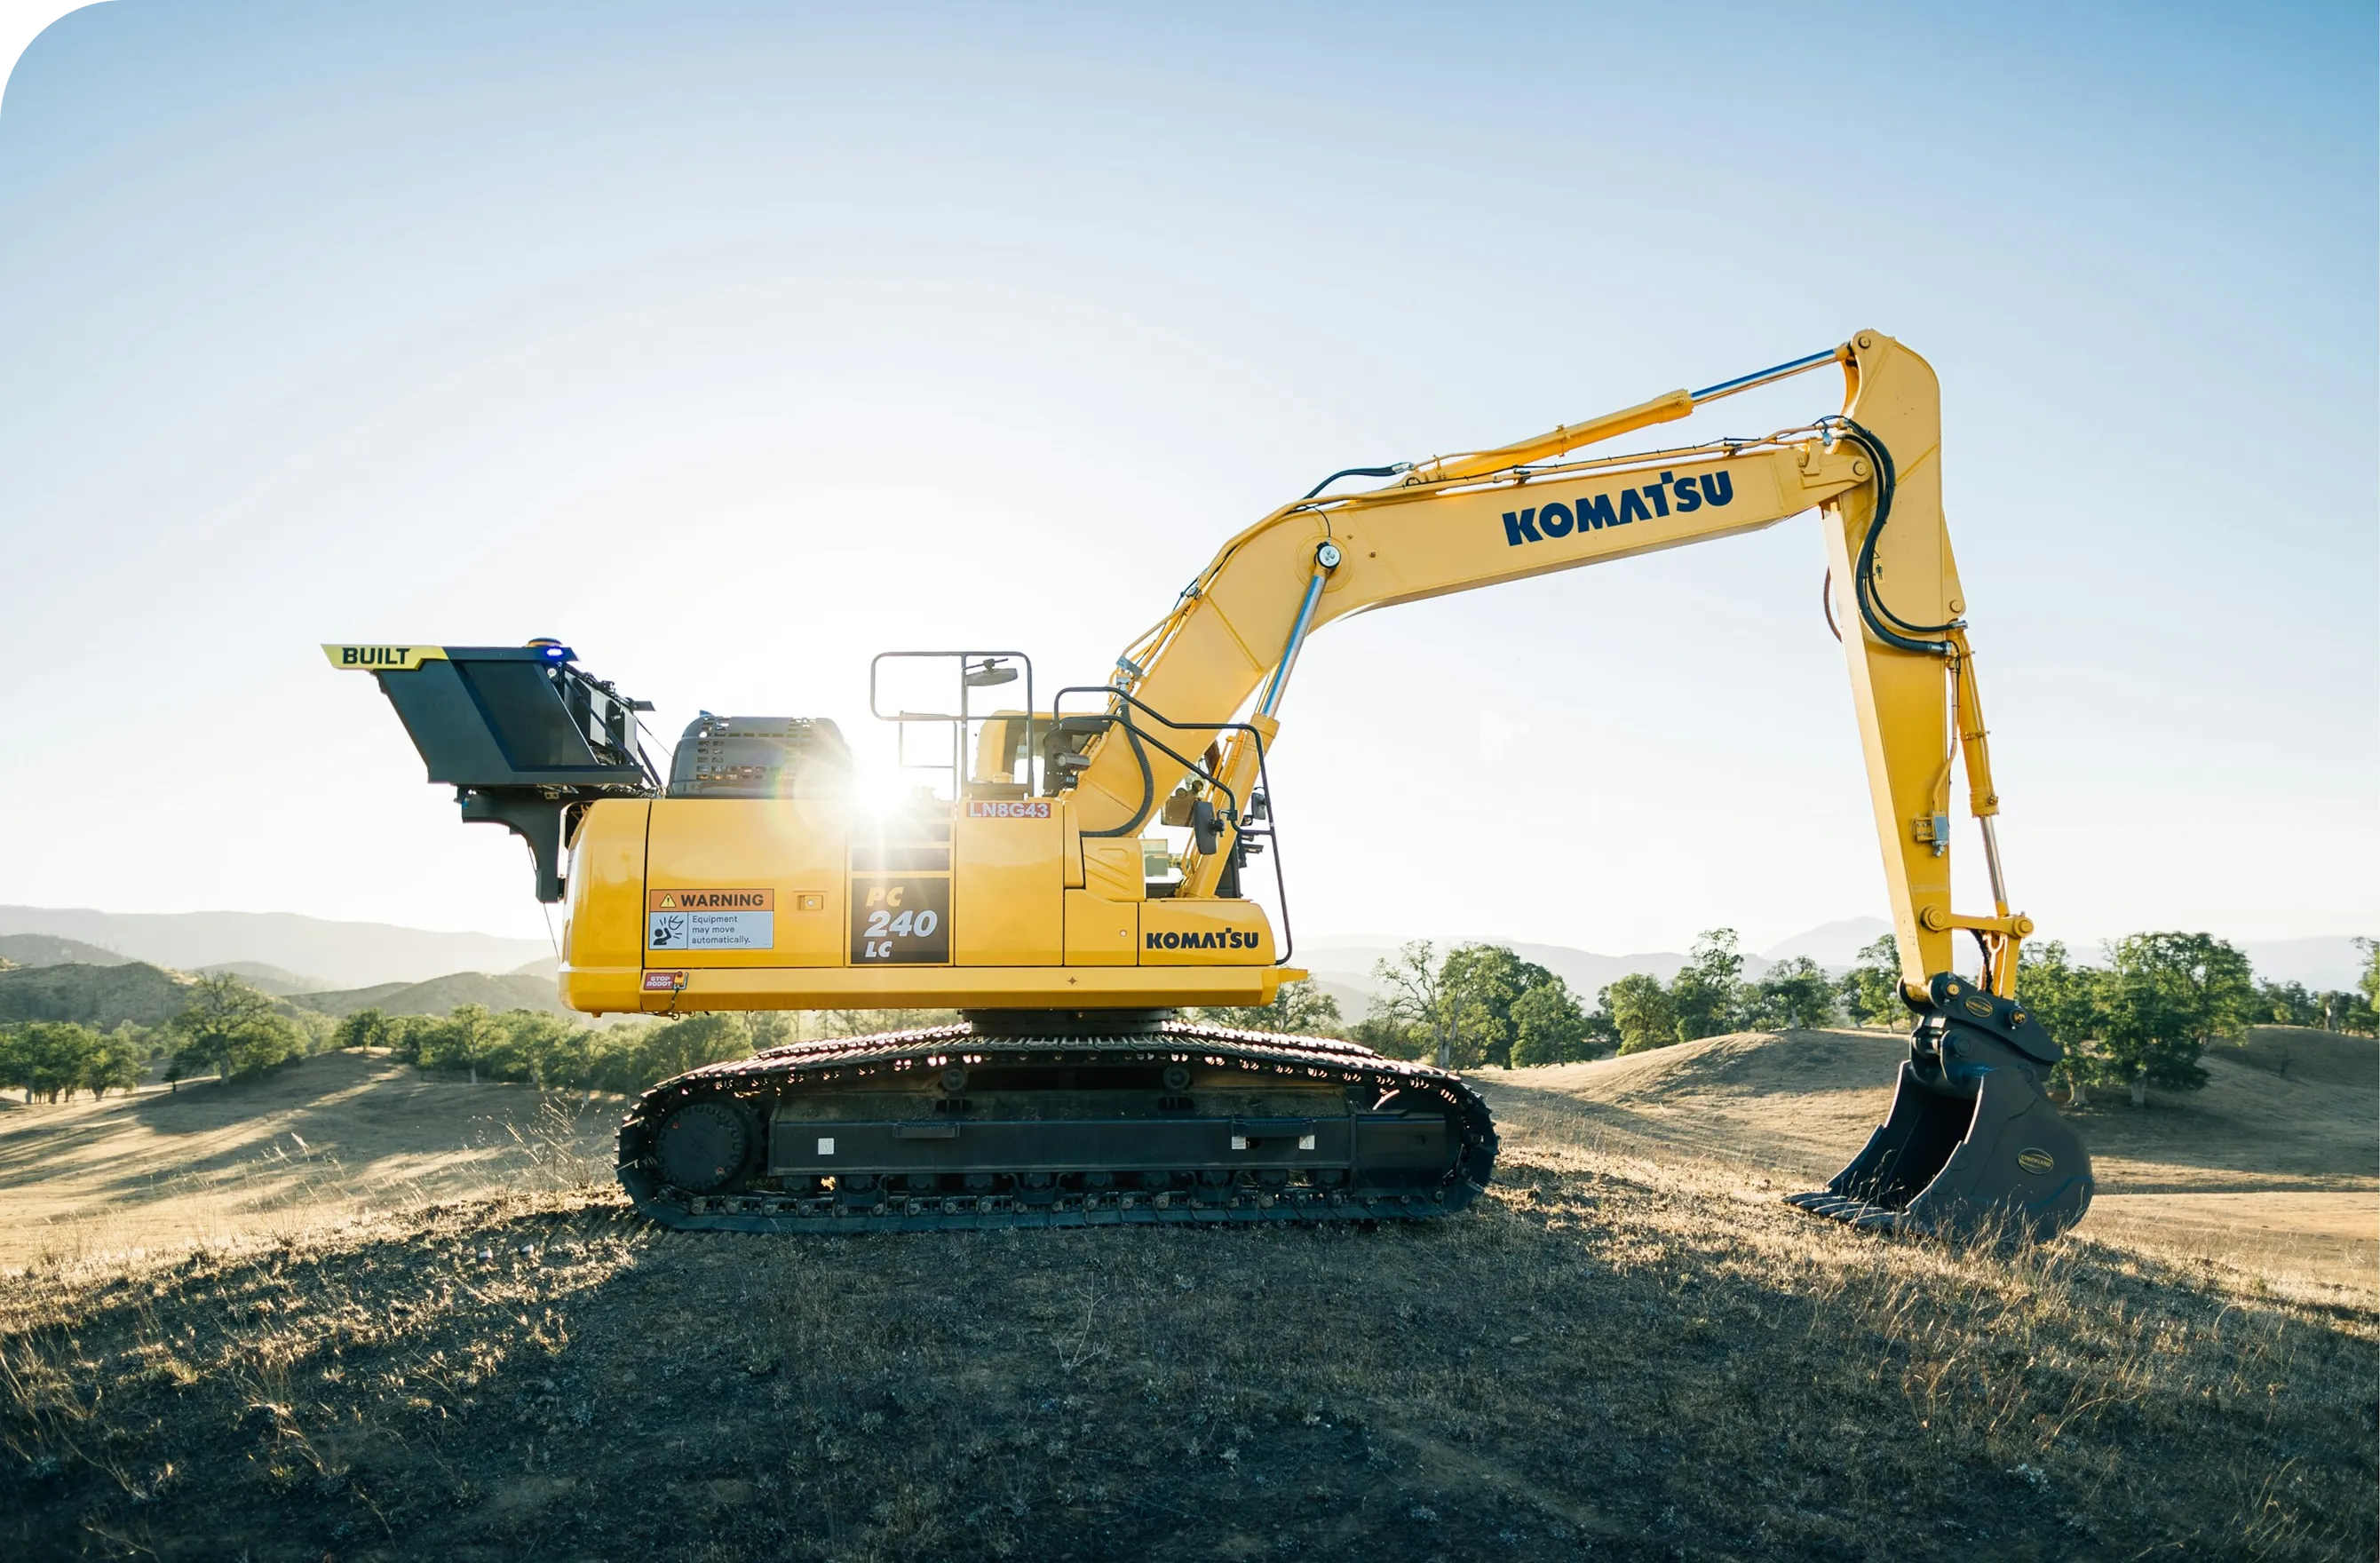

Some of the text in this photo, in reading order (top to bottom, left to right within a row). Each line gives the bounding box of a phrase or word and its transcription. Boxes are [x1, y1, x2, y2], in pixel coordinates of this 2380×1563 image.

[1502, 471, 1733, 546] KOMATSU
[342, 647, 410, 664] BUILT
[969, 803, 1049, 818] LN8G43
[681, 894, 764, 906] WARNING
[866, 886, 904, 907] PC
[692, 916, 738, 924] Equipment
[864, 910, 938, 937] 240
[1146, 928, 1259, 949] KOMATSU
[865, 941, 892, 957] LC
